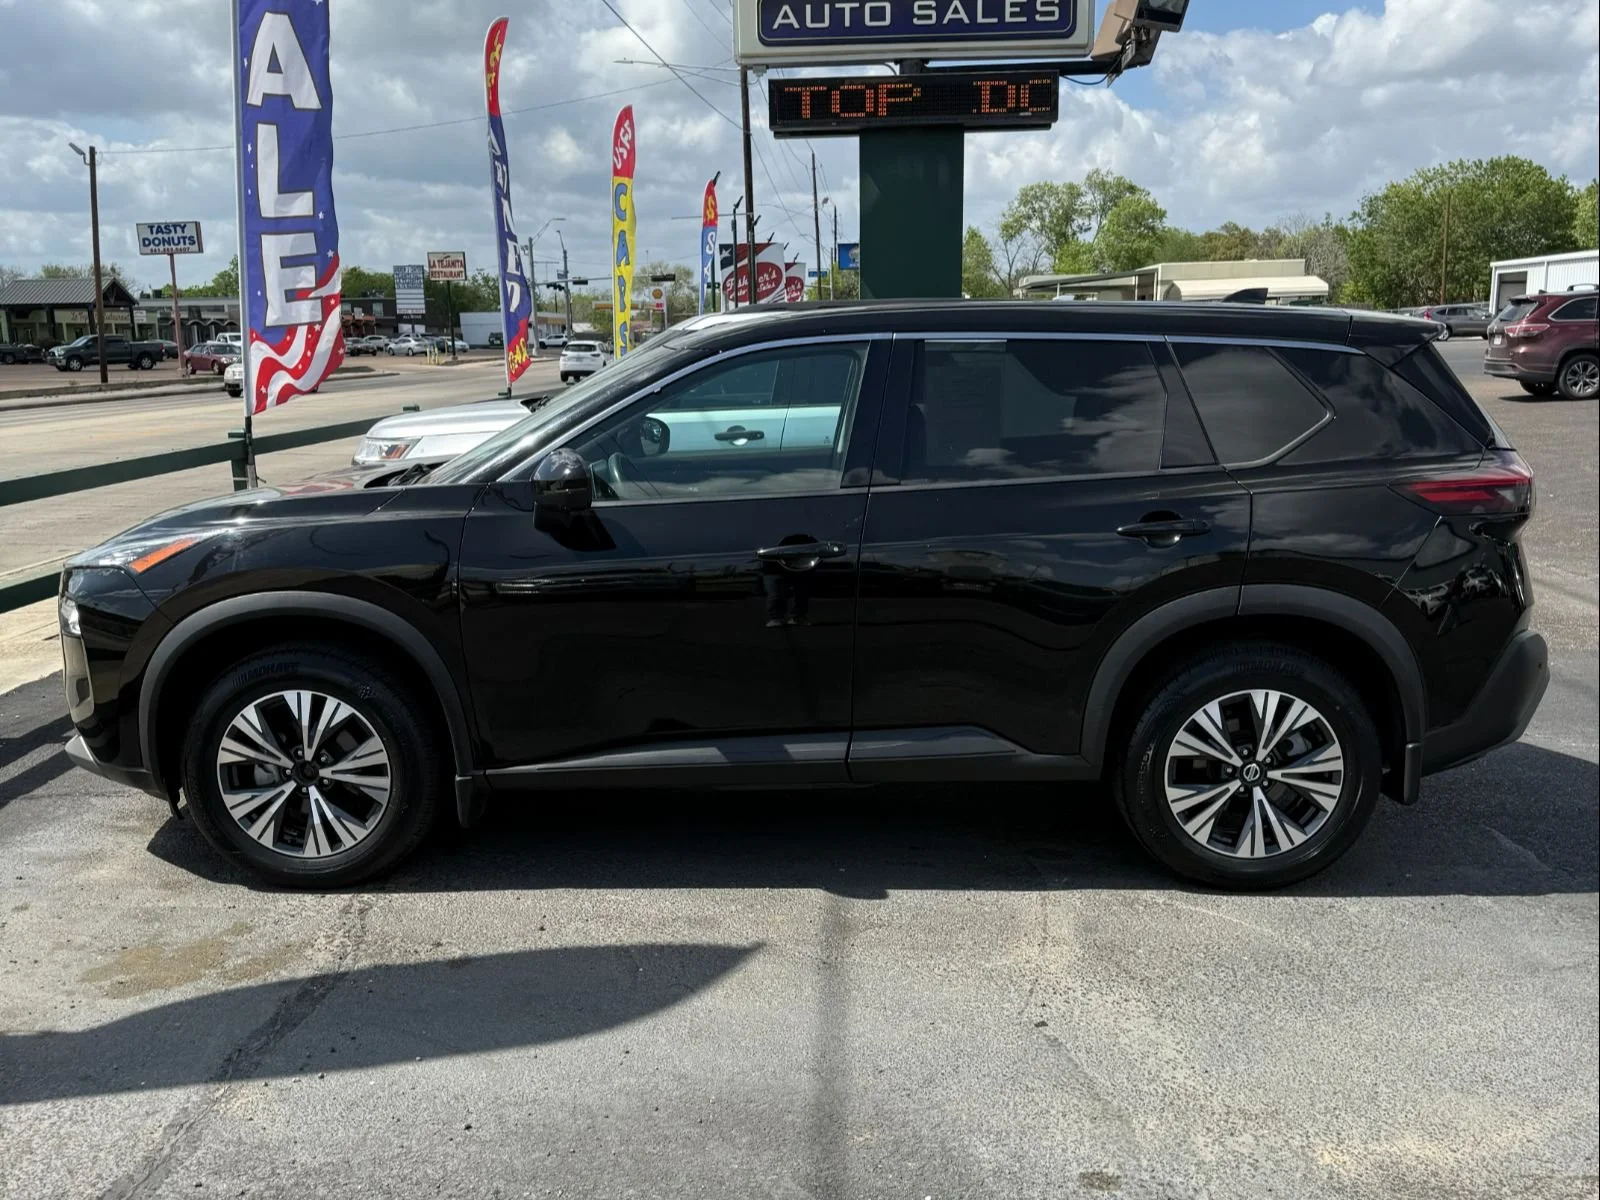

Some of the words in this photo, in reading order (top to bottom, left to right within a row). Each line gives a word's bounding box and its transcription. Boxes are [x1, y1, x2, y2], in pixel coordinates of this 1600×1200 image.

[772, 1, 892, 30] AUTO
[912, 0, 1060, 26] SALES
[784, 82, 922, 119] TOP
[147, 223, 187, 235] TASTY
[142, 235, 196, 247] DONUTS
